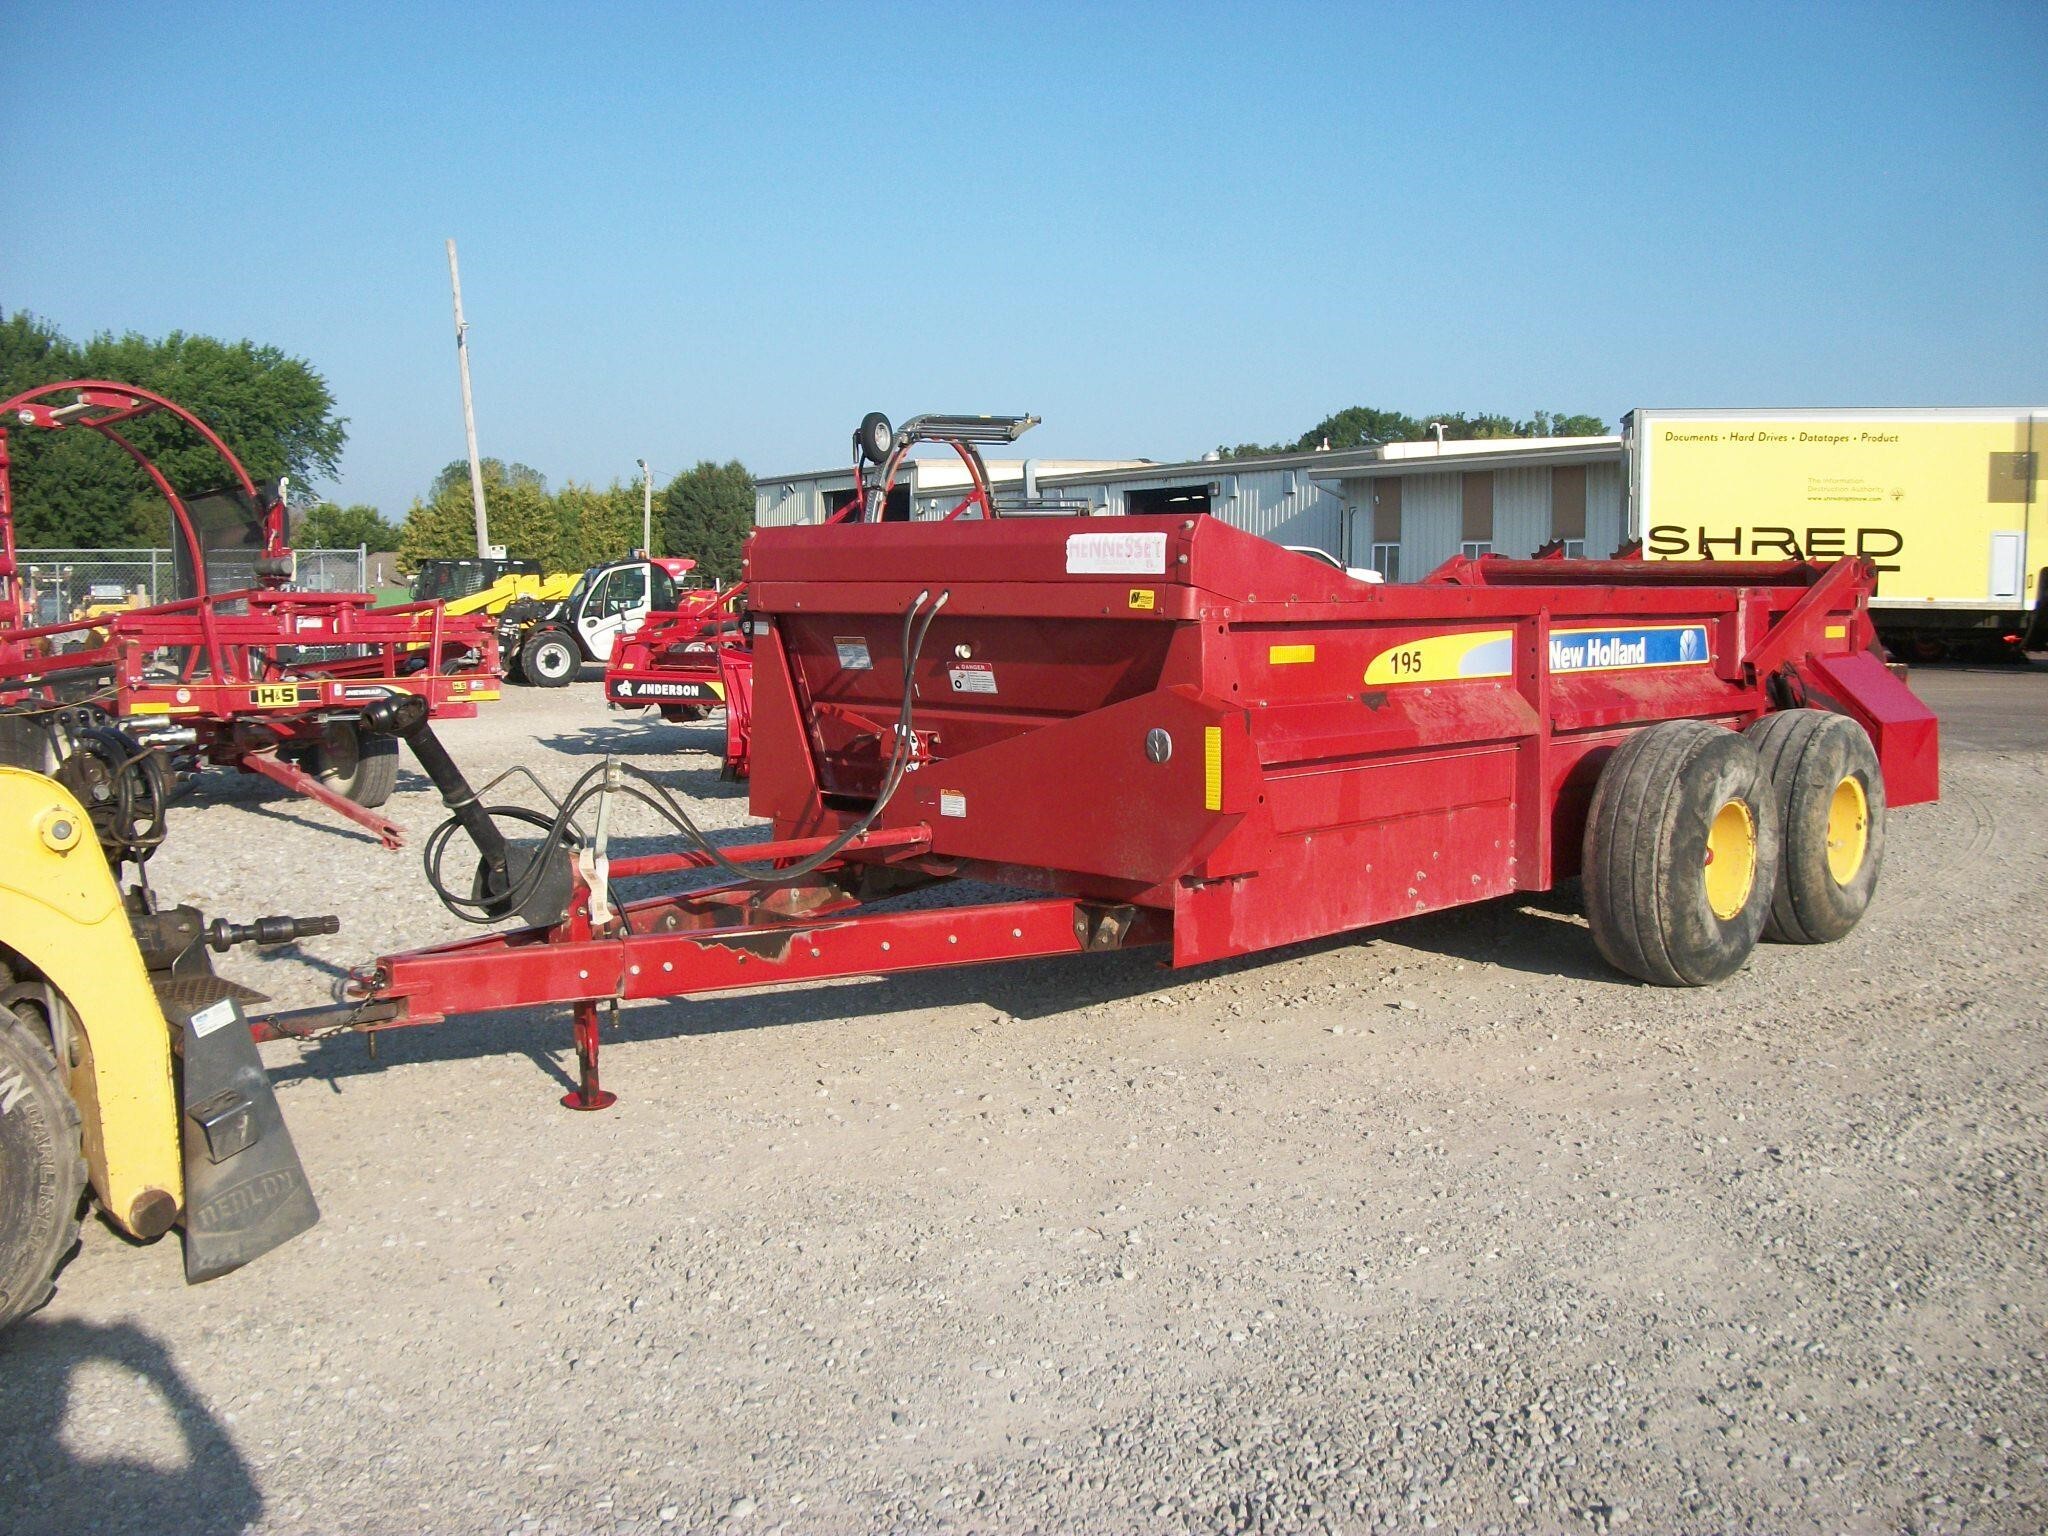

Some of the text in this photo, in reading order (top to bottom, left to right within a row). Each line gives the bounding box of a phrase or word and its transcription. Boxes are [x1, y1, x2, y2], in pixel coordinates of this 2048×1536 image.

[1665, 431, 1899, 445] Documents Hard Drives Datatapes Product
[1648, 525, 1904, 557] SHRED
[1549, 636, 1646, 669] New Holland
[961, 664, 986, 672] DANGER
[1390, 651, 1422, 675] 195
[261, 688, 294, 703] H&S
[637, 683, 700, 697] ANDERSON
